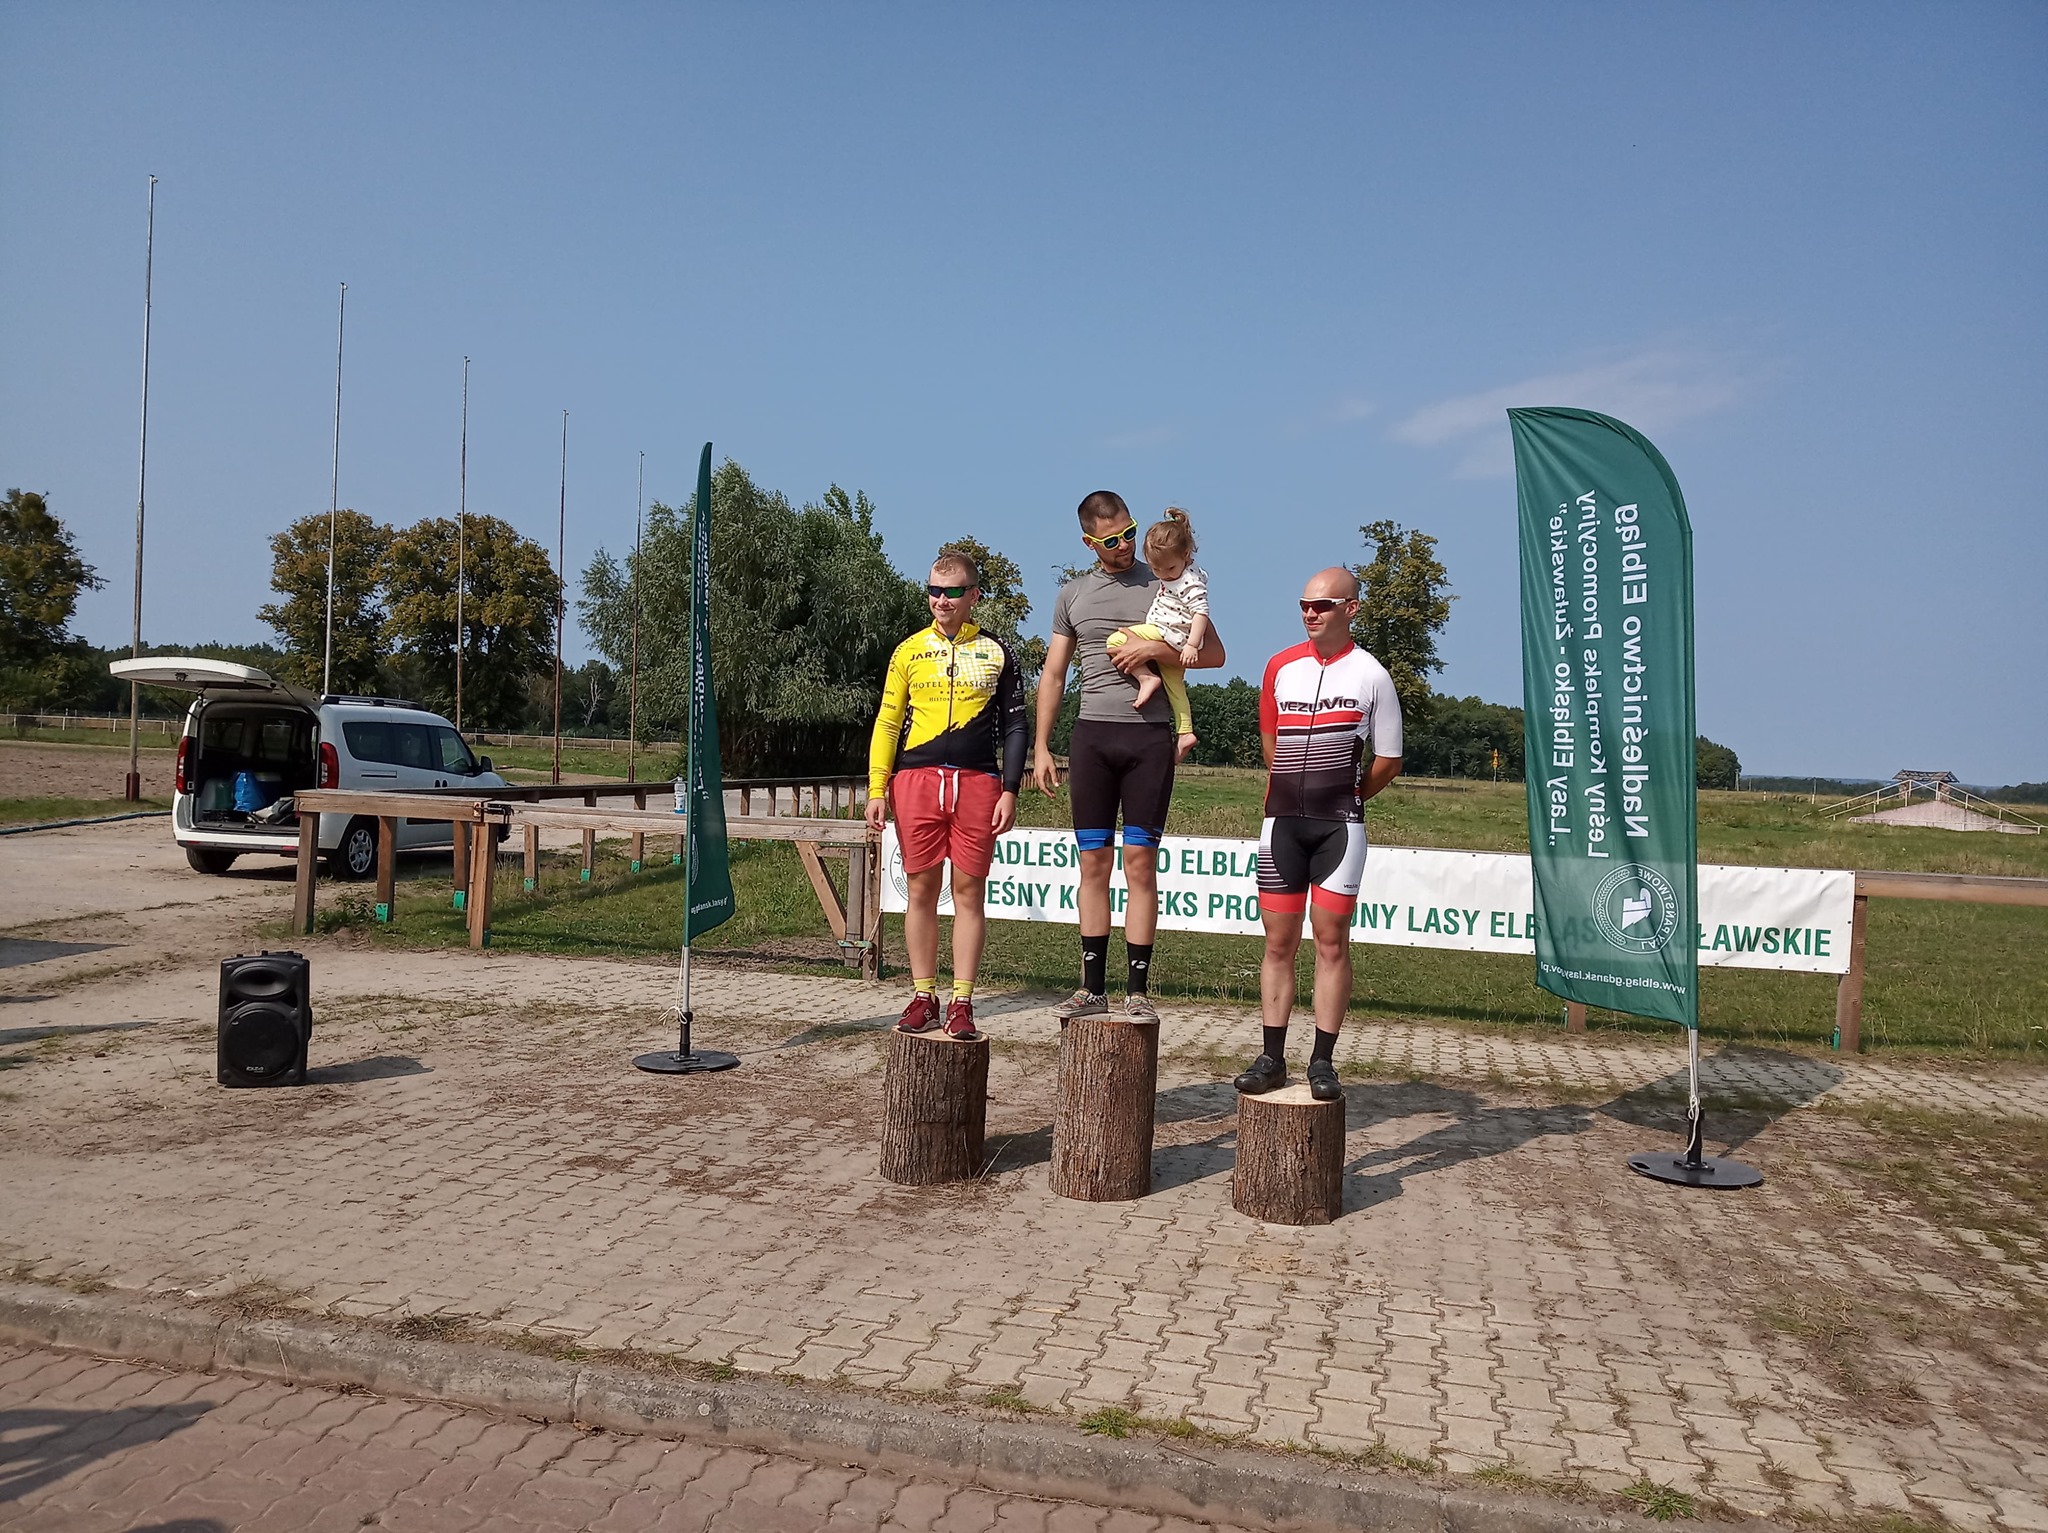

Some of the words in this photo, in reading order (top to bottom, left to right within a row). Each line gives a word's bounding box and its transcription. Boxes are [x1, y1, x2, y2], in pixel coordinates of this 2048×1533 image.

[910, 650, 948, 661] JARYS
[911, 681, 943, 690] HOTEL
[947, 680, 994, 689] KRASICK
[987, 875, 1051, 908] EŚNY
[1408, 906, 1481, 936] LASY
